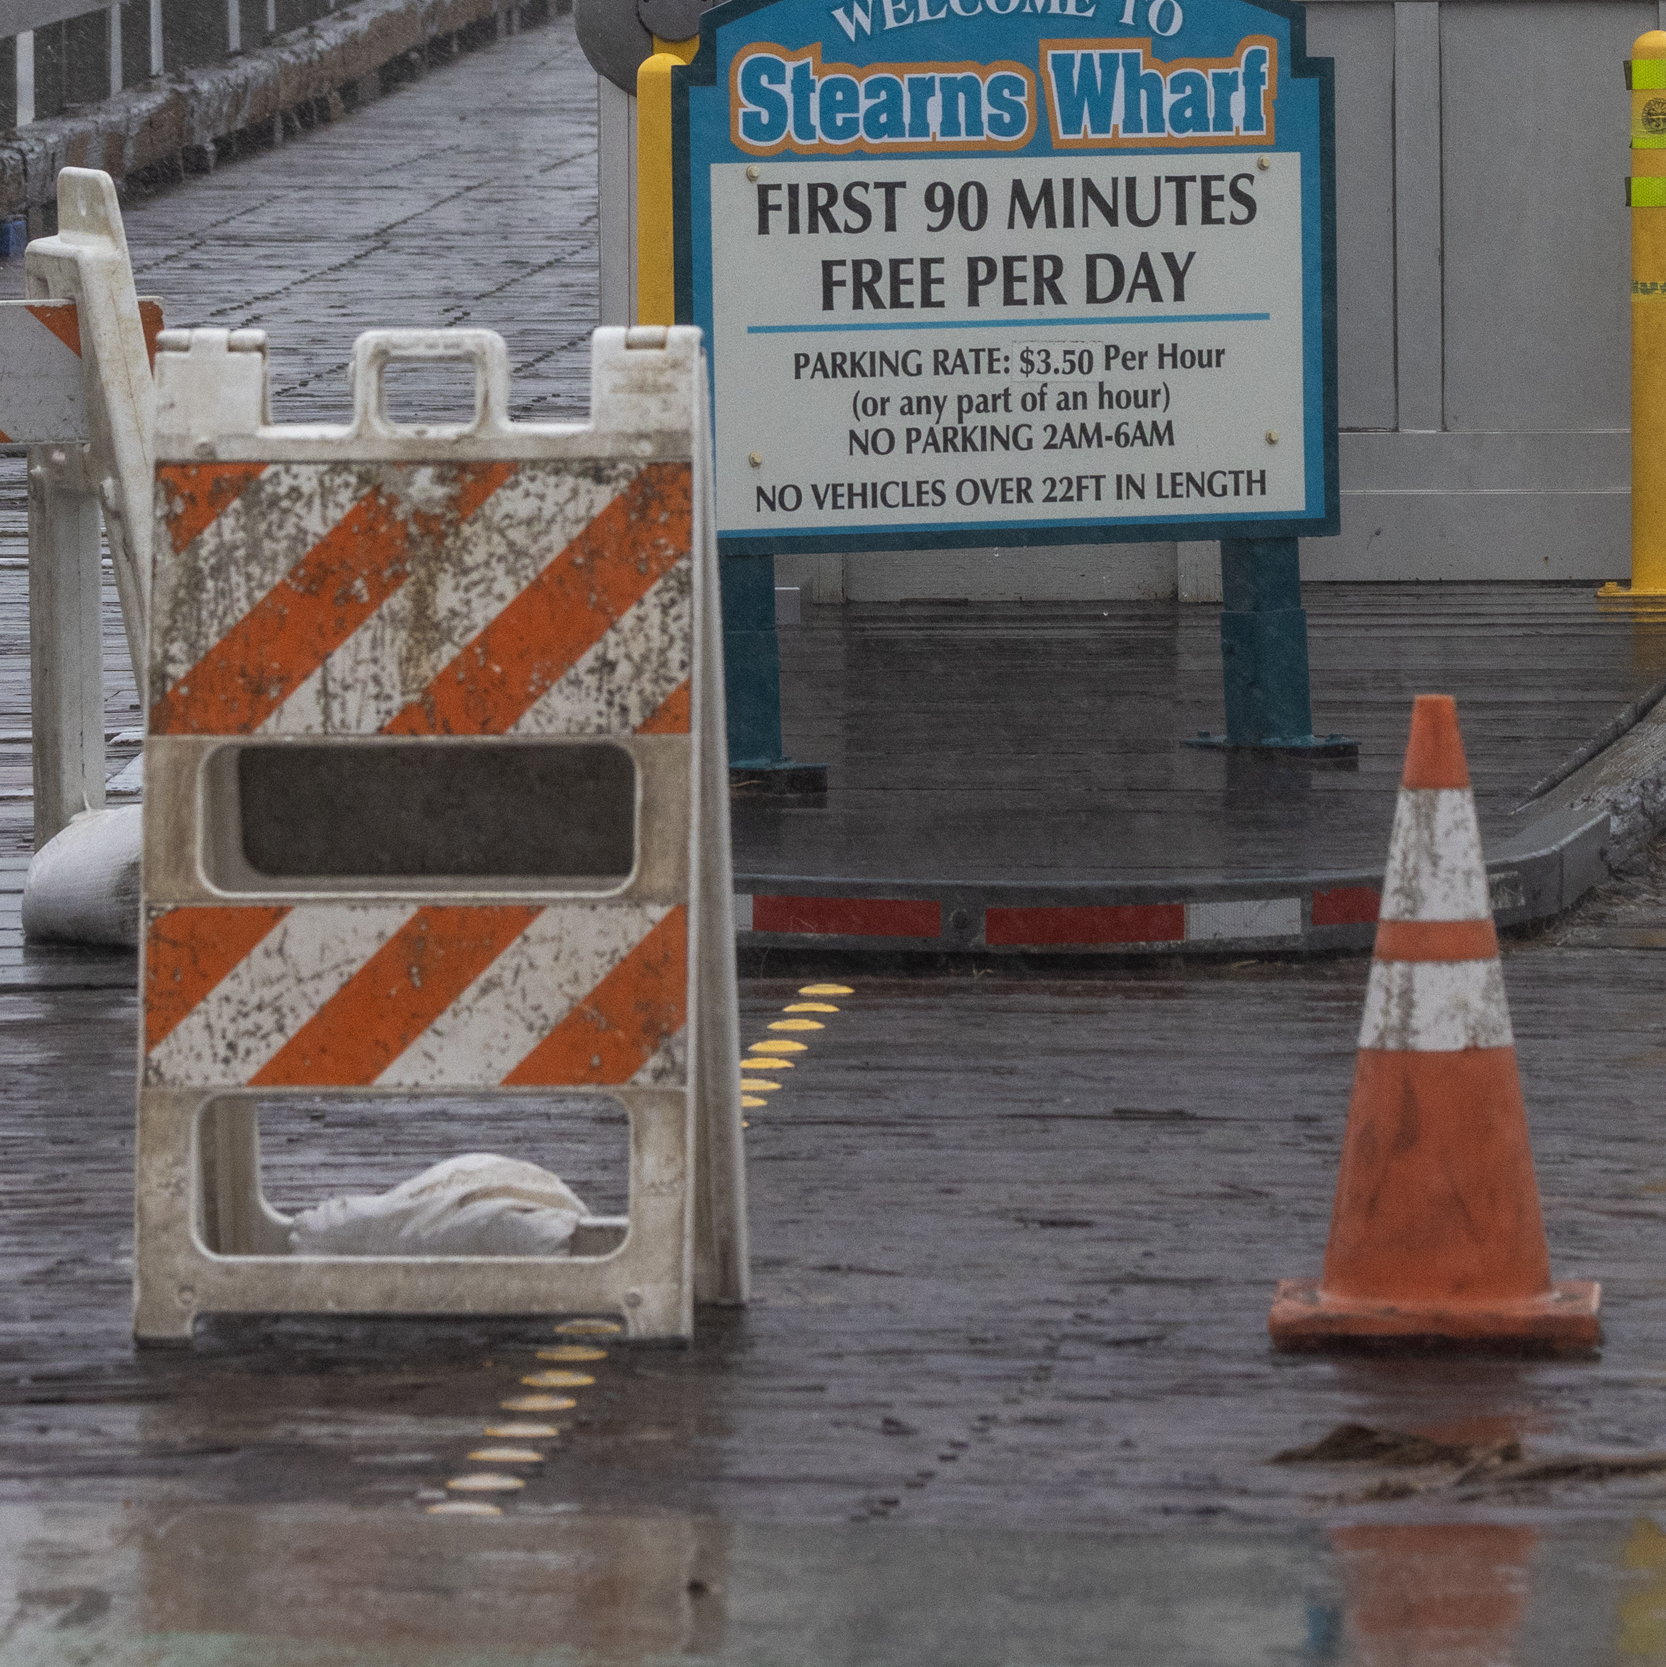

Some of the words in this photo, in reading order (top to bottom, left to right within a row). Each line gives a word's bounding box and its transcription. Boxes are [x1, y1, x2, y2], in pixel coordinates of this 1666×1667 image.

[736, 52, 1030, 145] Stearns
[1046, 45, 1271, 140] Wharf
[755, 180, 907, 236] FIRST
[923, 180, 989, 233] 90
[1007, 172, 1258, 230] MINUTES
[821, 257, 946, 311] FREE
[966, 254, 1067, 307] PER
[1085, 251, 1196, 305] DAY
[793, 349, 923, 380] PARKING
[932, 347, 1011, 376] RATE:
[1019, 347, 1094, 377] $3.50
[1104, 343, 1149, 372] Per
[1157, 343, 1226, 370] Hour
[851, 390, 891, 420] (or
[899, 394, 948, 425] any
[956, 387, 1013, 424] part
[1020, 384, 1049, 413] of
[1055, 390, 1088, 413] an
[1097, 382, 1172, 414] hour)
[848, 427, 896, 456] NO
[905, 423, 1033, 455] PARKING
[1042, 420, 1175, 450] 2AM-6AM
[755, 483, 803, 513] NO
[810, 479, 947, 511] VEHICLES
[955, 476, 1034, 506] OVER
[1041, 474, 1107, 503] 22FT
[1115, 473, 1146, 501] IN
[1156, 469, 1267, 499] LENGTH
